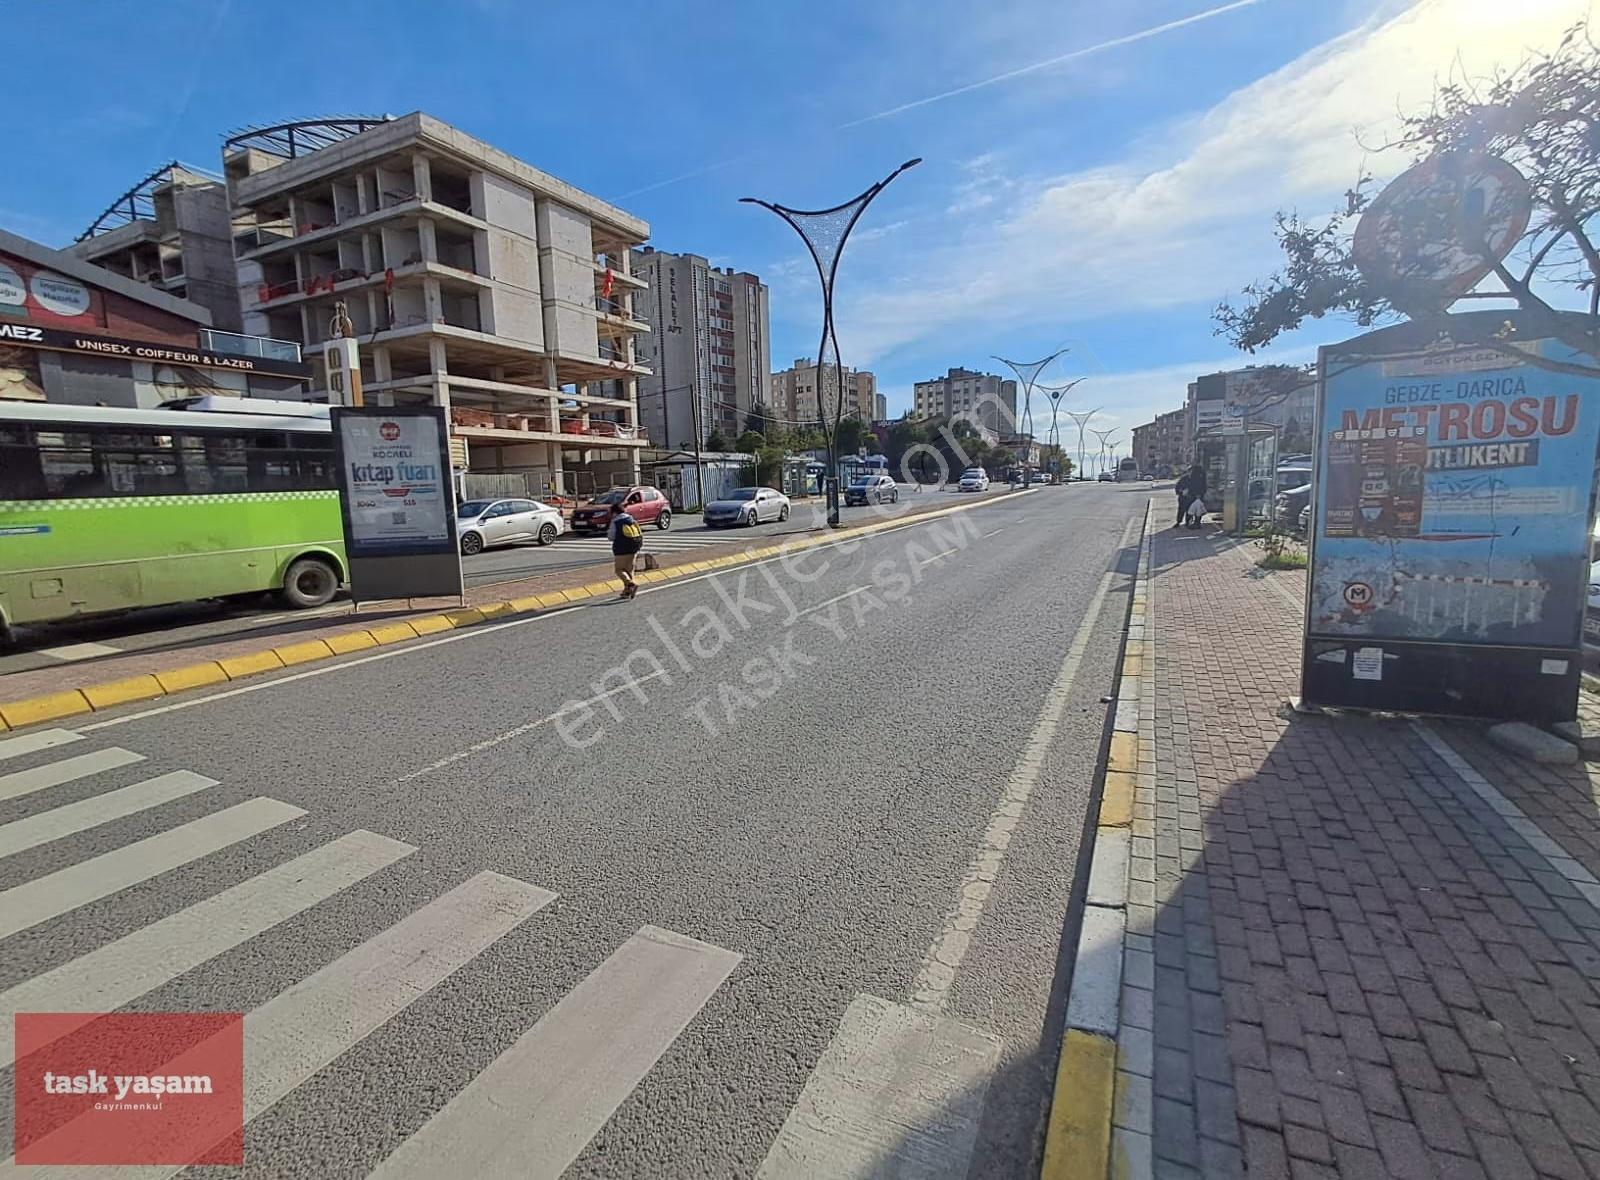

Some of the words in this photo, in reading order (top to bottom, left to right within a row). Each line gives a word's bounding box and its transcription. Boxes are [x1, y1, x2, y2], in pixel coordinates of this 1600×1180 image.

[75, 338, 131, 354] UNISEX
[136, 346, 200, 364] COIFFEUR
[203, 355, 212, 365] &
[214, 357, 255, 371] LAZER
[1384, 382, 1442, 404] GEBZE
[1456, 377, 1527, 399] DARICA
[1340, 394, 1579, 441] METROSU
